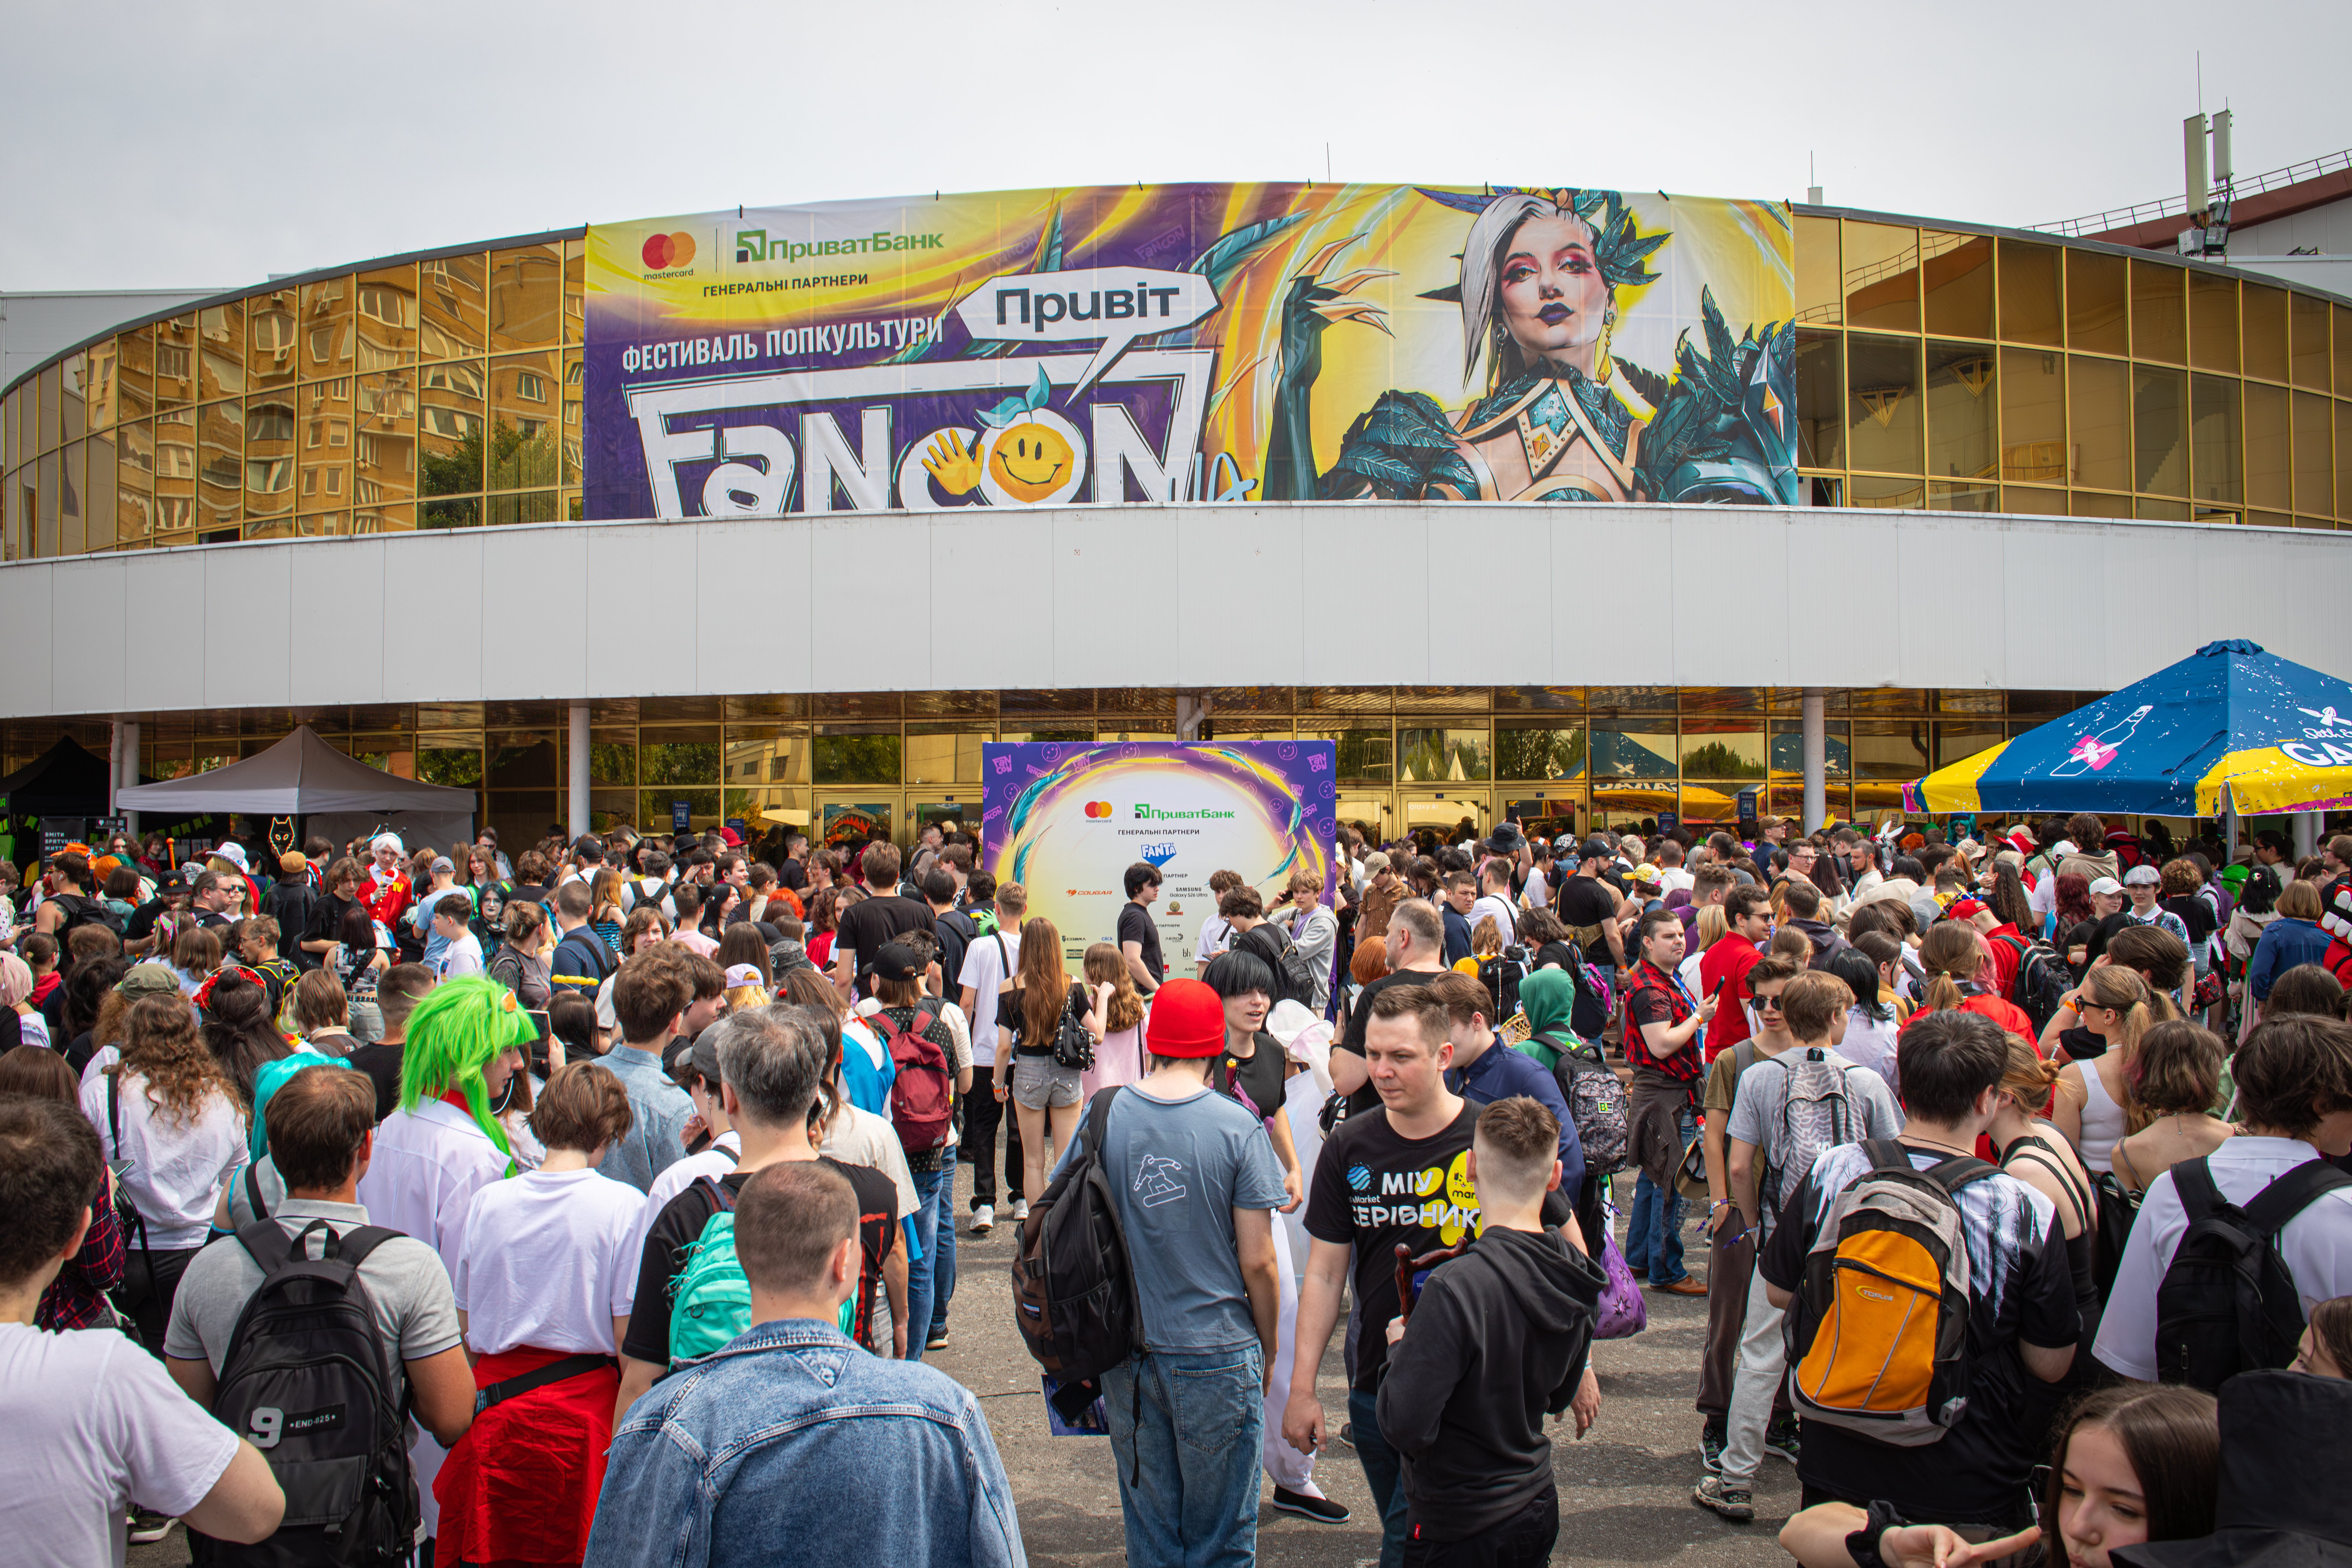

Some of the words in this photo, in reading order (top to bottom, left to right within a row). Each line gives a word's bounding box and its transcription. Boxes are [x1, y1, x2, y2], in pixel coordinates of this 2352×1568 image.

[770, 227, 944, 264] ПриватБанк
[644, 269, 694, 281] mastercard
[703, 279, 787, 298] ГЕНЕРАЛЬНІ
[792, 273, 868, 292] ПАРТНЕРИ
[996, 282, 1179, 332] Привіт
[622, 331, 757, 374] ФЕСТИВАЛЬ
[765, 317, 943, 359] ПОПКУЛЬТУРИ
[1152, 809, 1235, 821] ПриватБанк
[1141, 843, 1176, 858] FANTA
[1863, 1289, 1894, 1302] TOPLINE
[248, 1407, 284, 1448] 9
